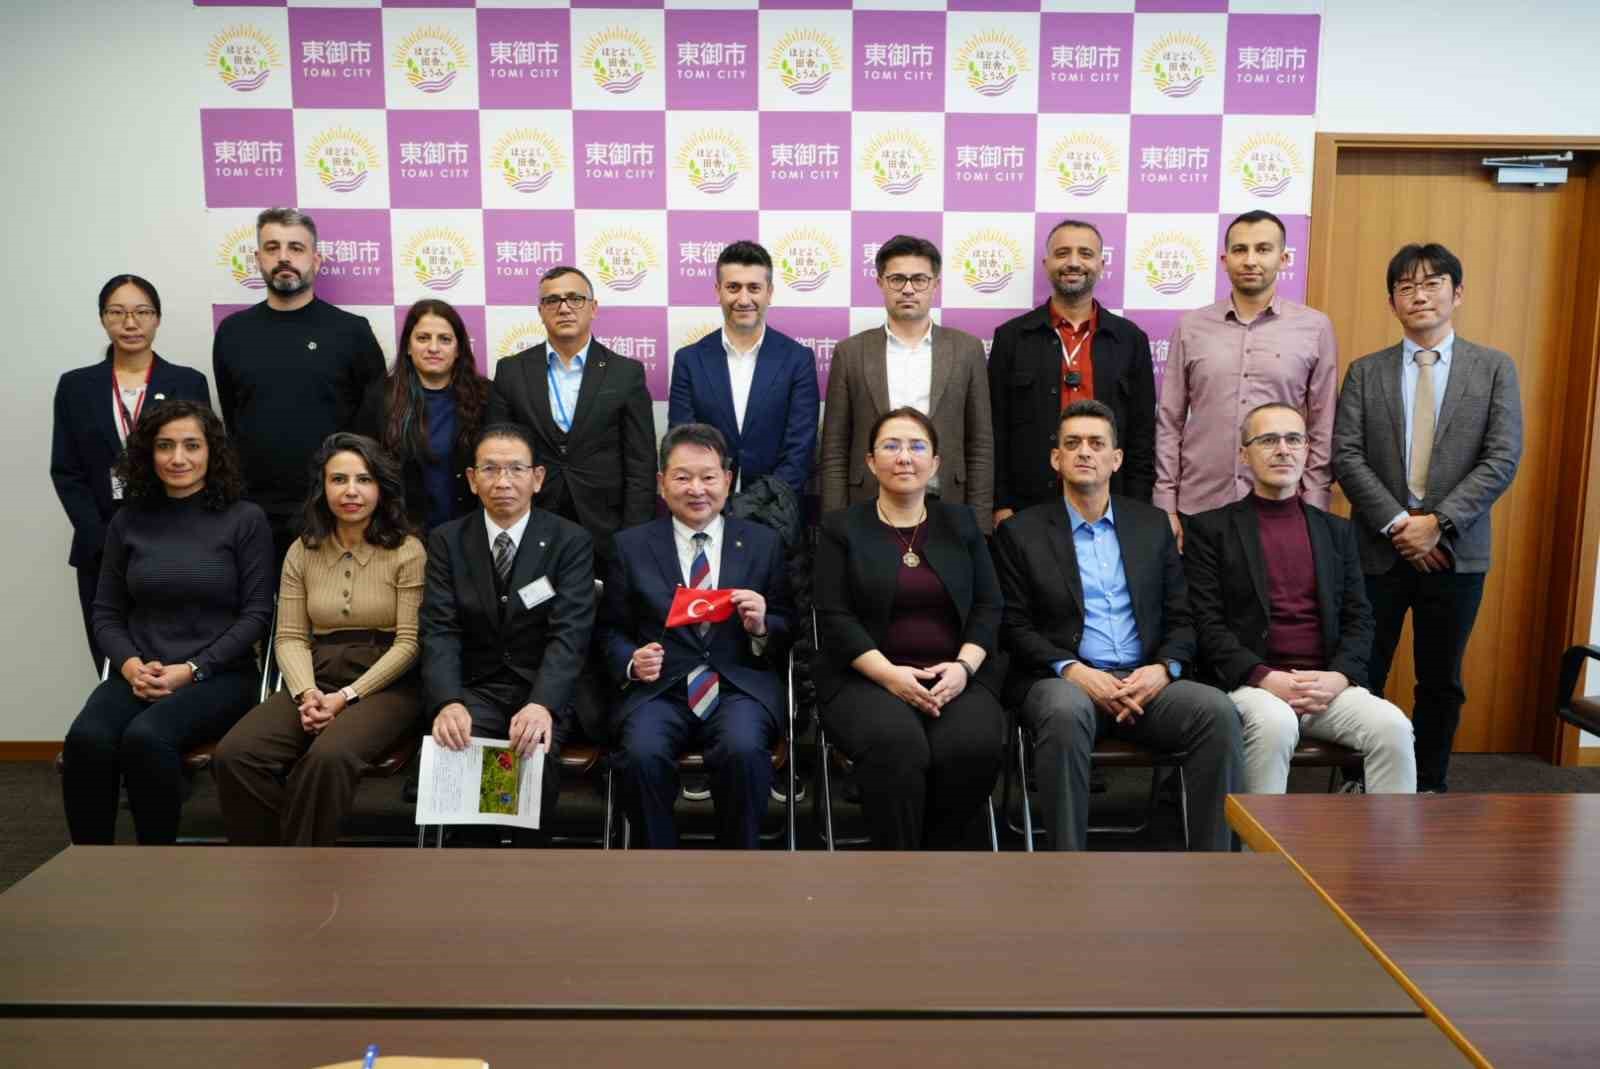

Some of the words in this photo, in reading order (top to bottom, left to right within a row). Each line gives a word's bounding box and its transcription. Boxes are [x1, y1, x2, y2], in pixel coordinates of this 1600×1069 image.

[303, 41, 371, 64] 東御市
[490, 42, 558, 65] 東御市
[678, 42, 746, 65] 東御市
[865, 44, 933, 66] 東御市
[1052, 46, 1120, 69] 東御市
[1238, 47, 1306, 70] 東御市
[234, 66, 255, 76] とうみ
[304, 68, 336, 77] TOMI
[343, 68, 371, 77] CITY
[422, 68, 443, 77] とうみ
[491, 69, 523, 78] TOMI
[530, 69, 558, 78] CITY
[609, 68, 630, 78] とうみ
[678, 70, 709, 79] TOMI
[718, 70, 745, 79] CITY
[796, 69, 817, 78] とうみ
[864, 71, 896, 80] TOMI
[904, 71, 932, 80] CITY
[983, 71, 1004, 80] とうみ
[1051, 73, 1083, 82] TOMI
[1091, 73, 1118, 82] CITY
[1169, 72, 1191, 82] とうみ
[1238, 74, 1269, 83] TOMI
[1277, 74, 1304, 83] CITY
[215, 141, 282, 164] 東御市
[400, 142, 468, 165] 東御市
[586, 143, 654, 165] 東御市
[772, 144, 839, 166] 東御市
[957, 145, 1024, 168] 東御市
[1142, 147, 1209, 169] 東御市
[216, 168, 248, 176] TOMI
[255, 168, 283, 176] CITY
[333, 168, 354, 177] とうみ
[401, 169, 433, 177] TOMI
[440, 169, 468, 177] CITY
[518, 168, 539, 177] とうみ
[586, 169, 618, 178] TOMI
[625, 169, 653, 178] CITY
[703, 169, 725, 178] とうみ
[772, 170, 803, 179] TOMI
[810, 170, 838, 179] CITY
[888, 170, 910, 179] とうみ
[957, 172, 988, 181] TOMI
[995, 172, 1024, 181] CITY
[1073, 172, 1095, 181] とうみ
[1141, 173, 1172, 182] TOMI
[1179, 173, 1208, 182] CITY
[1257, 173, 1279, 182] とうみ
[496, 241, 564, 264] 東御市
[680, 241, 728, 264] 東御
[318, 266, 346, 275] OMI
[353, 266, 381, 275] CITY
[429, 266, 451, 275] とうみ
[497, 267, 528, 276] TOMI
[613, 266, 634, 276] とうみ
[680, 268, 712, 277] TOMI
[796, 267, 817, 276] とうみ
[979, 269, 1000, 278] とうみ
[1161, 270, 1183, 279] とうみ
